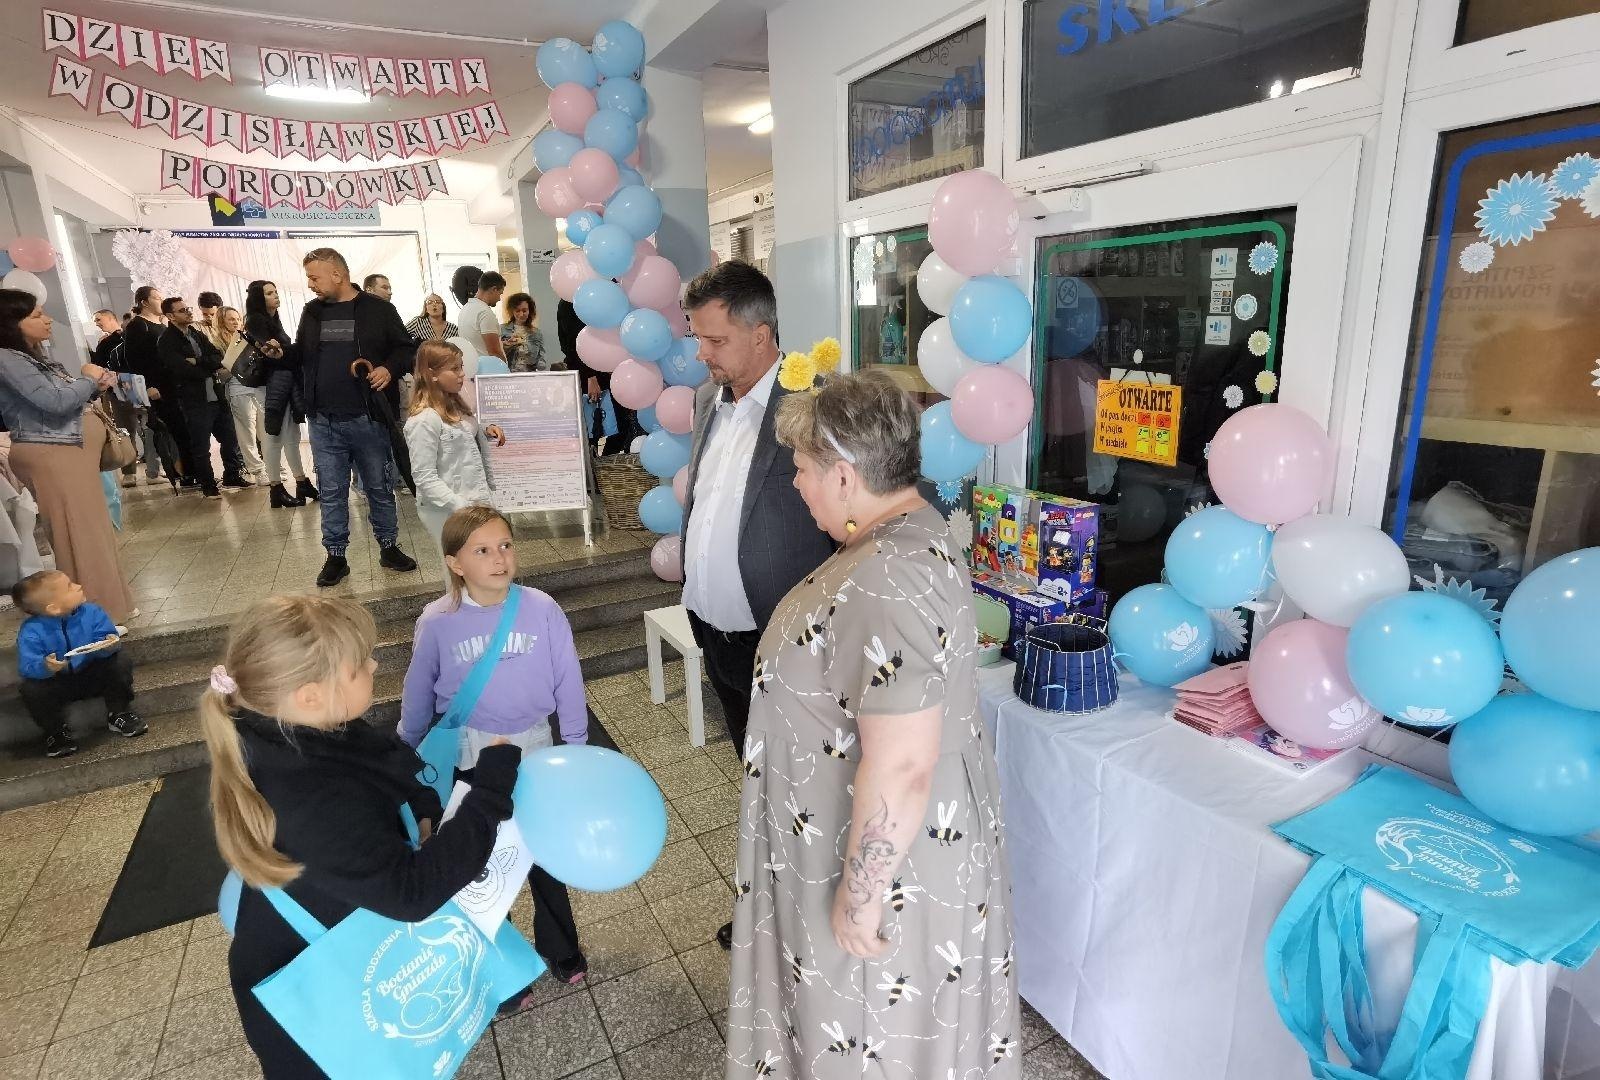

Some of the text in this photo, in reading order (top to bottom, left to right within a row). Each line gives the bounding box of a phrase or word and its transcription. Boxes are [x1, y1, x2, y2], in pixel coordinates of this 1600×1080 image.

[46, 13, 482, 86] DZIEŃ OTWARTY
[170, 156, 437, 198] PORODÓWKI
[1119, 388, 1172, 412] OTWARTE
[362, 928, 404, 1032] SZKOŁA RODZENIA
[392, 954, 447, 1004] Gniazdo
